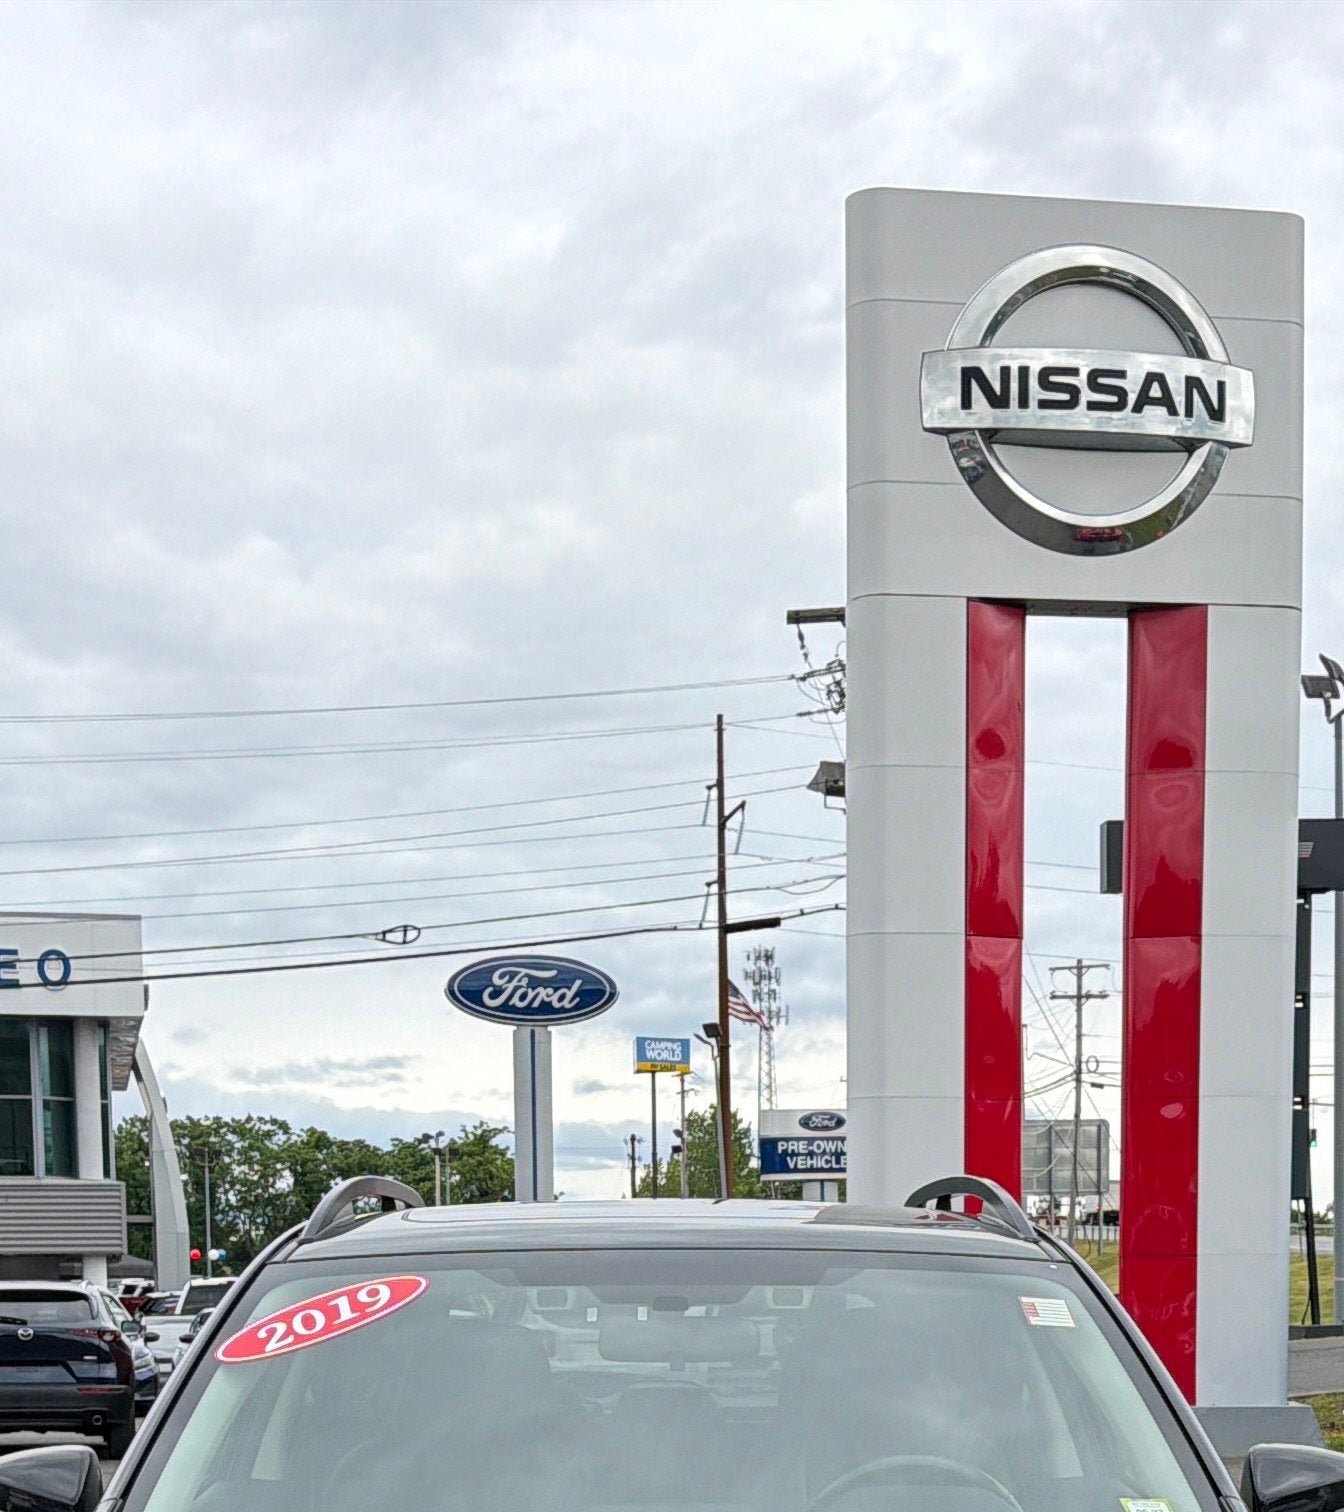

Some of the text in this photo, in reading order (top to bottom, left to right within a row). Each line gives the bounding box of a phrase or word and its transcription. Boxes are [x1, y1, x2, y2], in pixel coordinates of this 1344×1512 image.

[960, 365, 1226, 423] NISSAN
[482, 966, 583, 1009] Ford
[644, 1039, 682, 1050] CAMPING
[645, 1050, 682, 1061] WORLD
[808, 1114, 838, 1128] Ford
[257, 1283, 391, 1353] 2019
